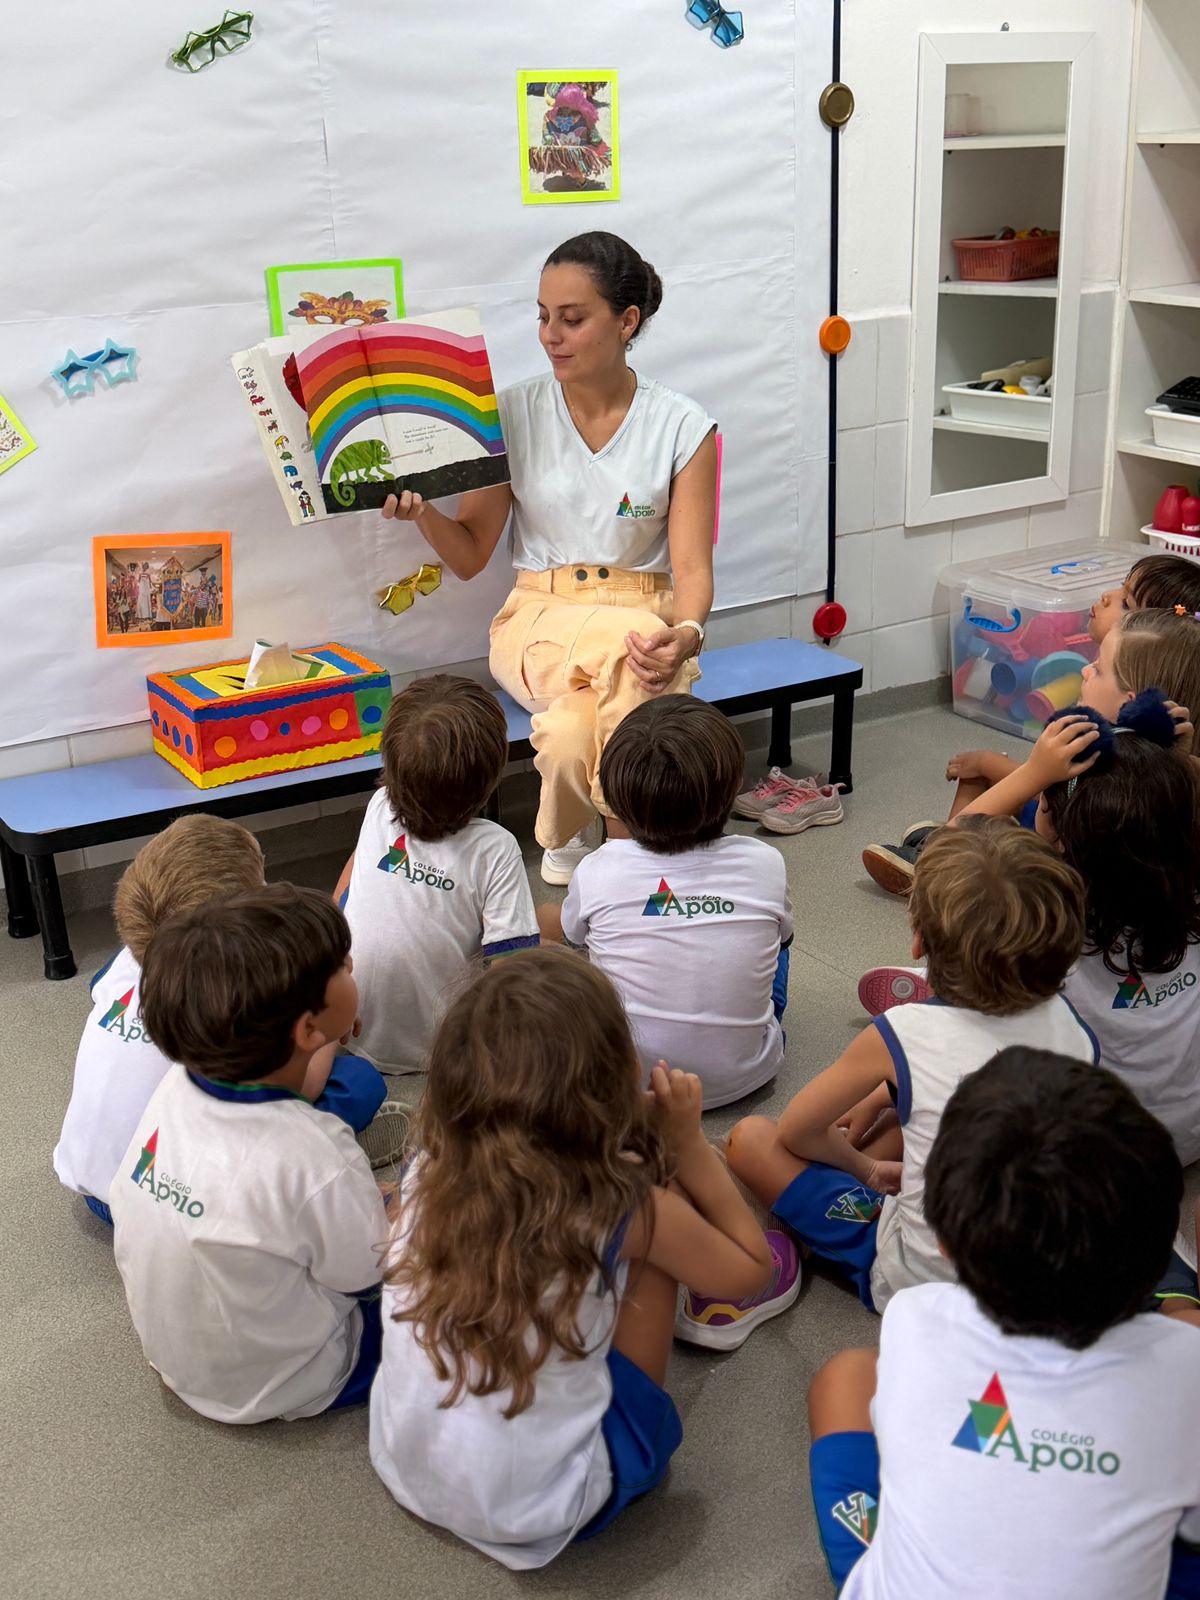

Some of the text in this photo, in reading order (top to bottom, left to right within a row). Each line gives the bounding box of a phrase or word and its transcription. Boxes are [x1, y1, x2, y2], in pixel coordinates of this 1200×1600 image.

[413, 861, 445, 875] COLÉGIO
[661, 892, 735, 919] Apoio
[1130, 971, 1197, 1009] Apoio
[985, 1413, 1121, 1477] Apoio
[1031, 1428, 1095, 1447] COLÉGIO
